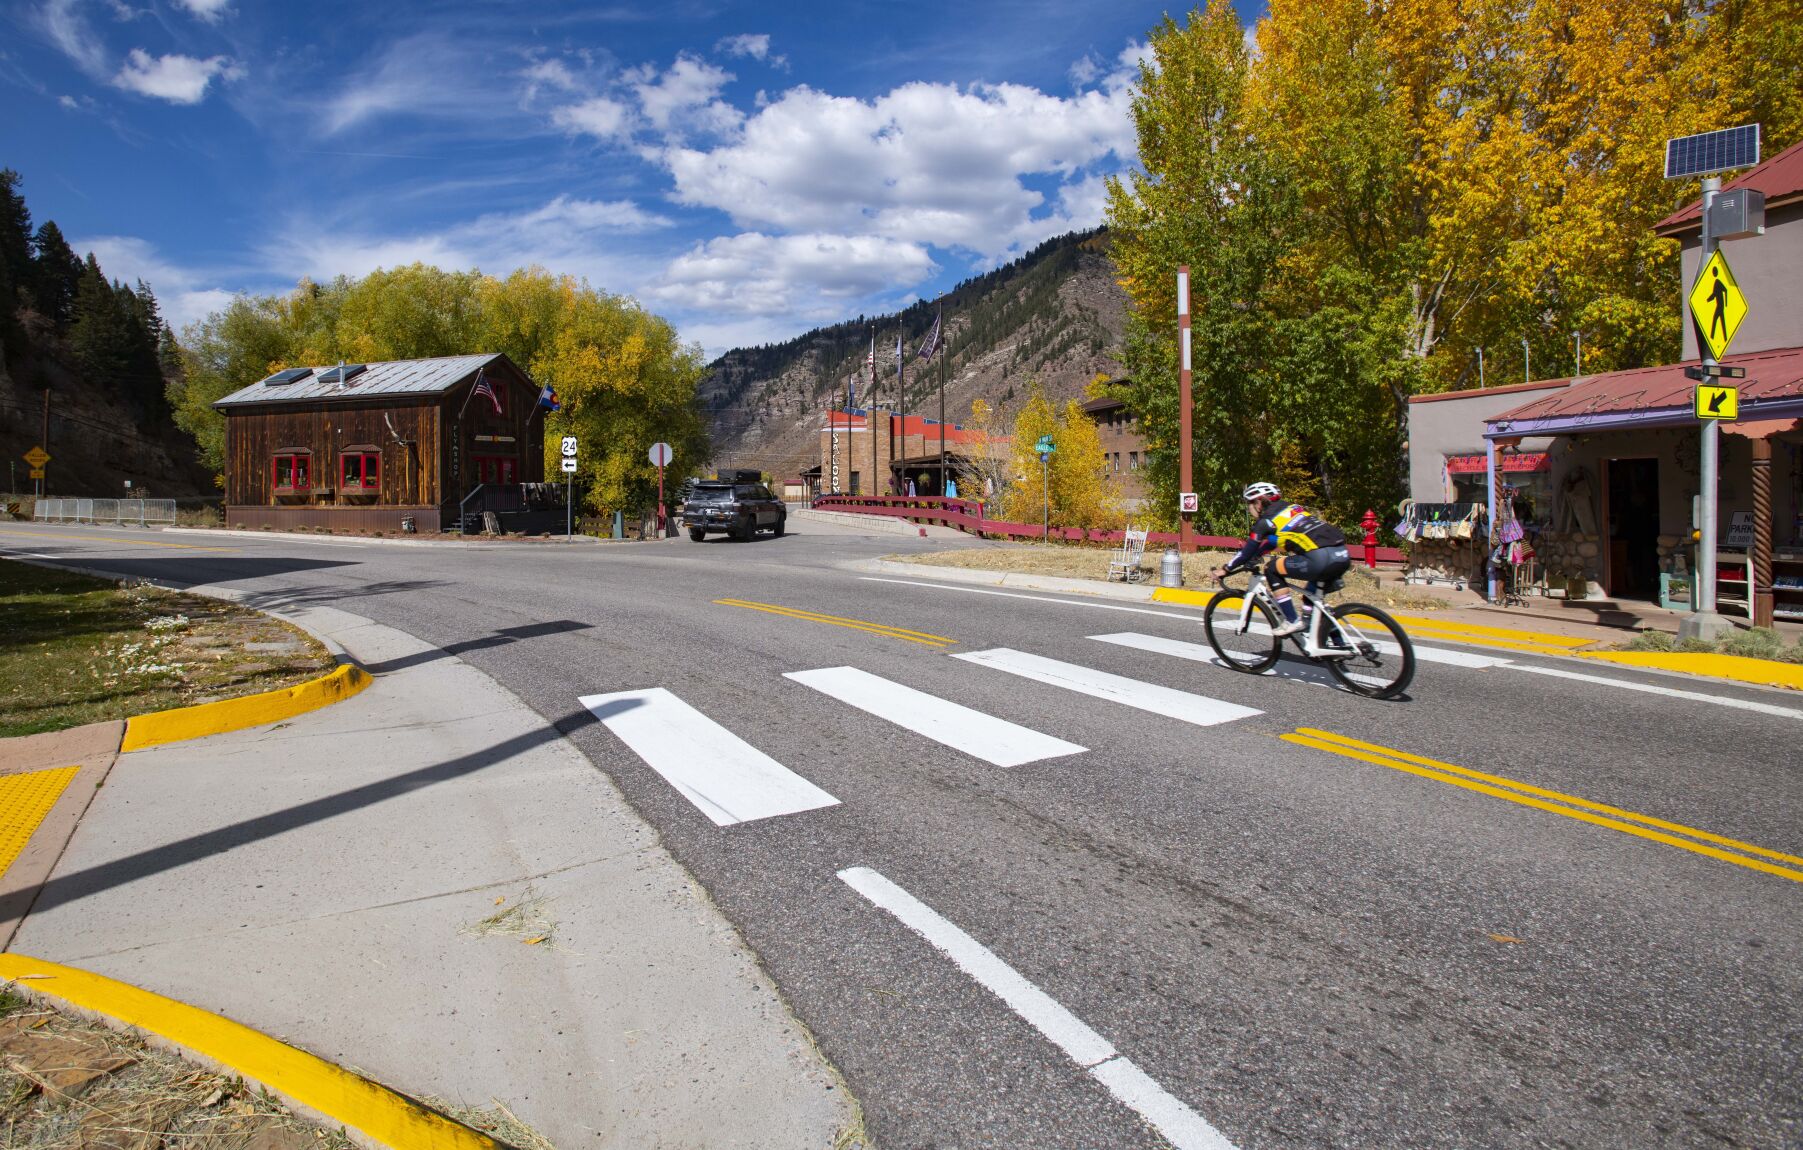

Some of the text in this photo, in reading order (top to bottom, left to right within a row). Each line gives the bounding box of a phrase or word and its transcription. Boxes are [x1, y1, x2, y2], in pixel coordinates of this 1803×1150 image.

[563, 441, 576, 452] 24
[832, 433, 840, 494] SALOON
[1730, 524, 1754, 533] PARK
